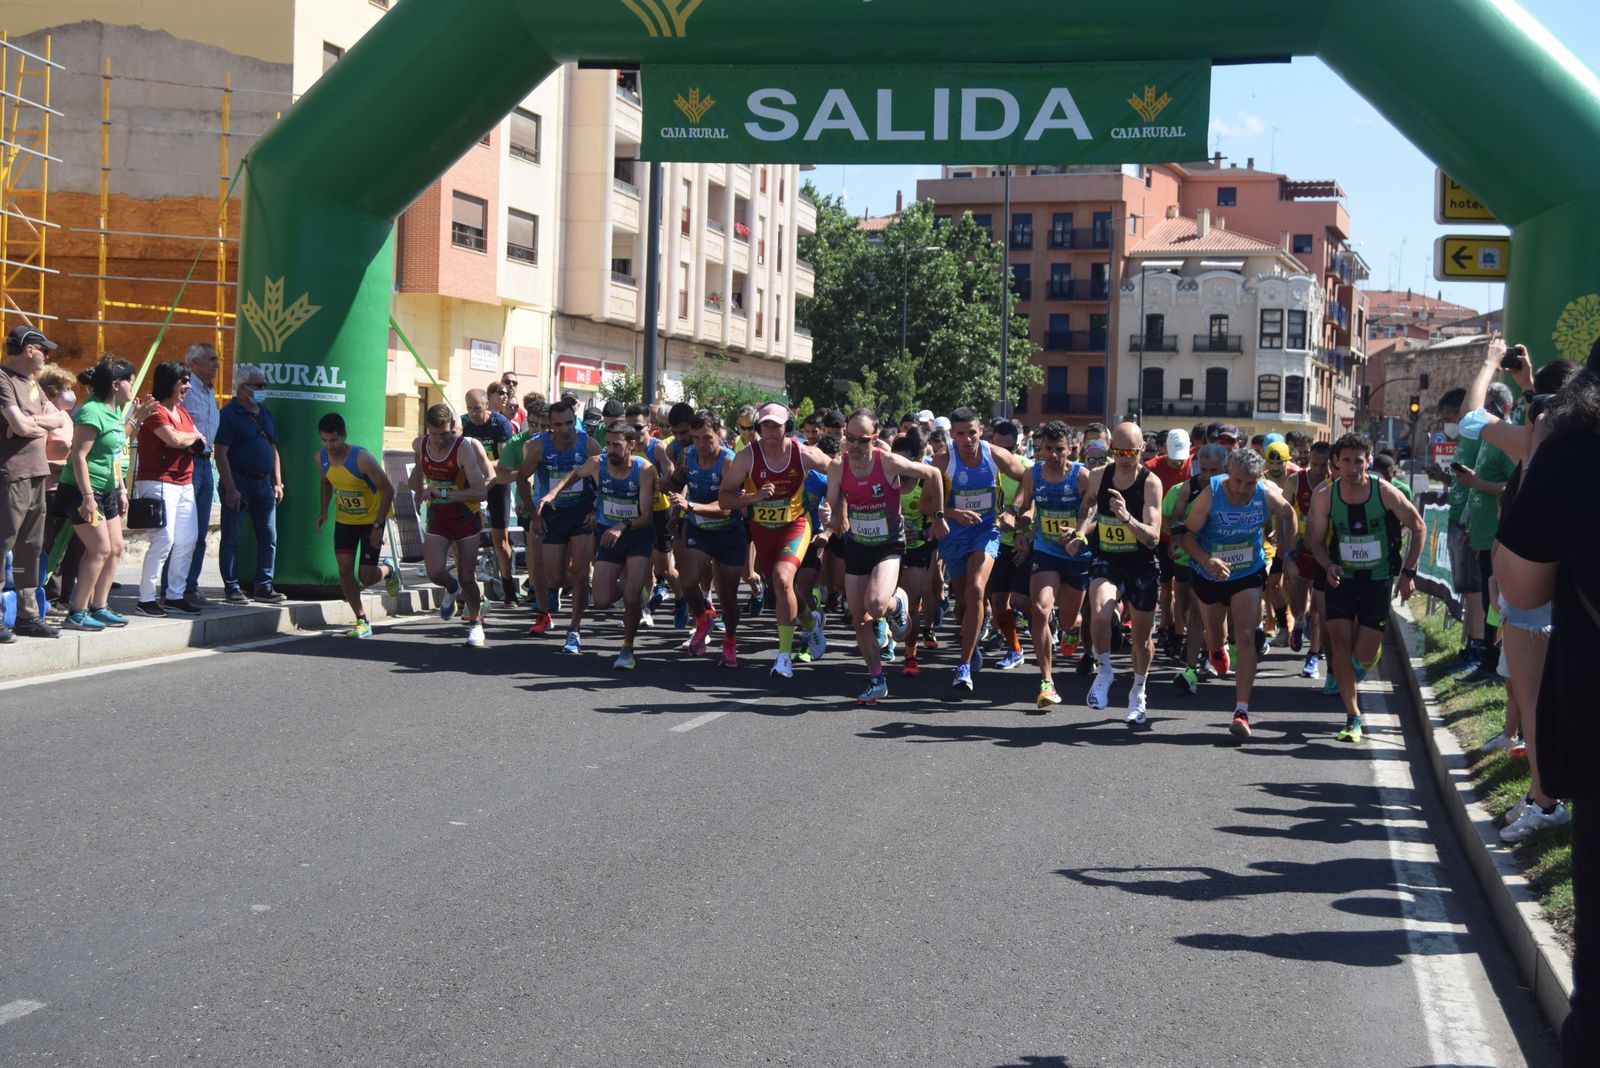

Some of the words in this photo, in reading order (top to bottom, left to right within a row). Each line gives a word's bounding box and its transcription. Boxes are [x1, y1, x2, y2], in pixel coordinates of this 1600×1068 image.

[743, 87, 1093, 142] SALIDA
[660, 127, 687, 139] CAJA
[688, 127, 729, 139] RURAL
[1110, 127, 1141, 139] CAJA
[1142, 126, 1186, 138] RURAL
[260, 362, 347, 389] RURAL
[312, 393, 338, 401] ZAMORA
[758, 507, 787, 521] 227
[1105, 526, 1125, 542] 49
